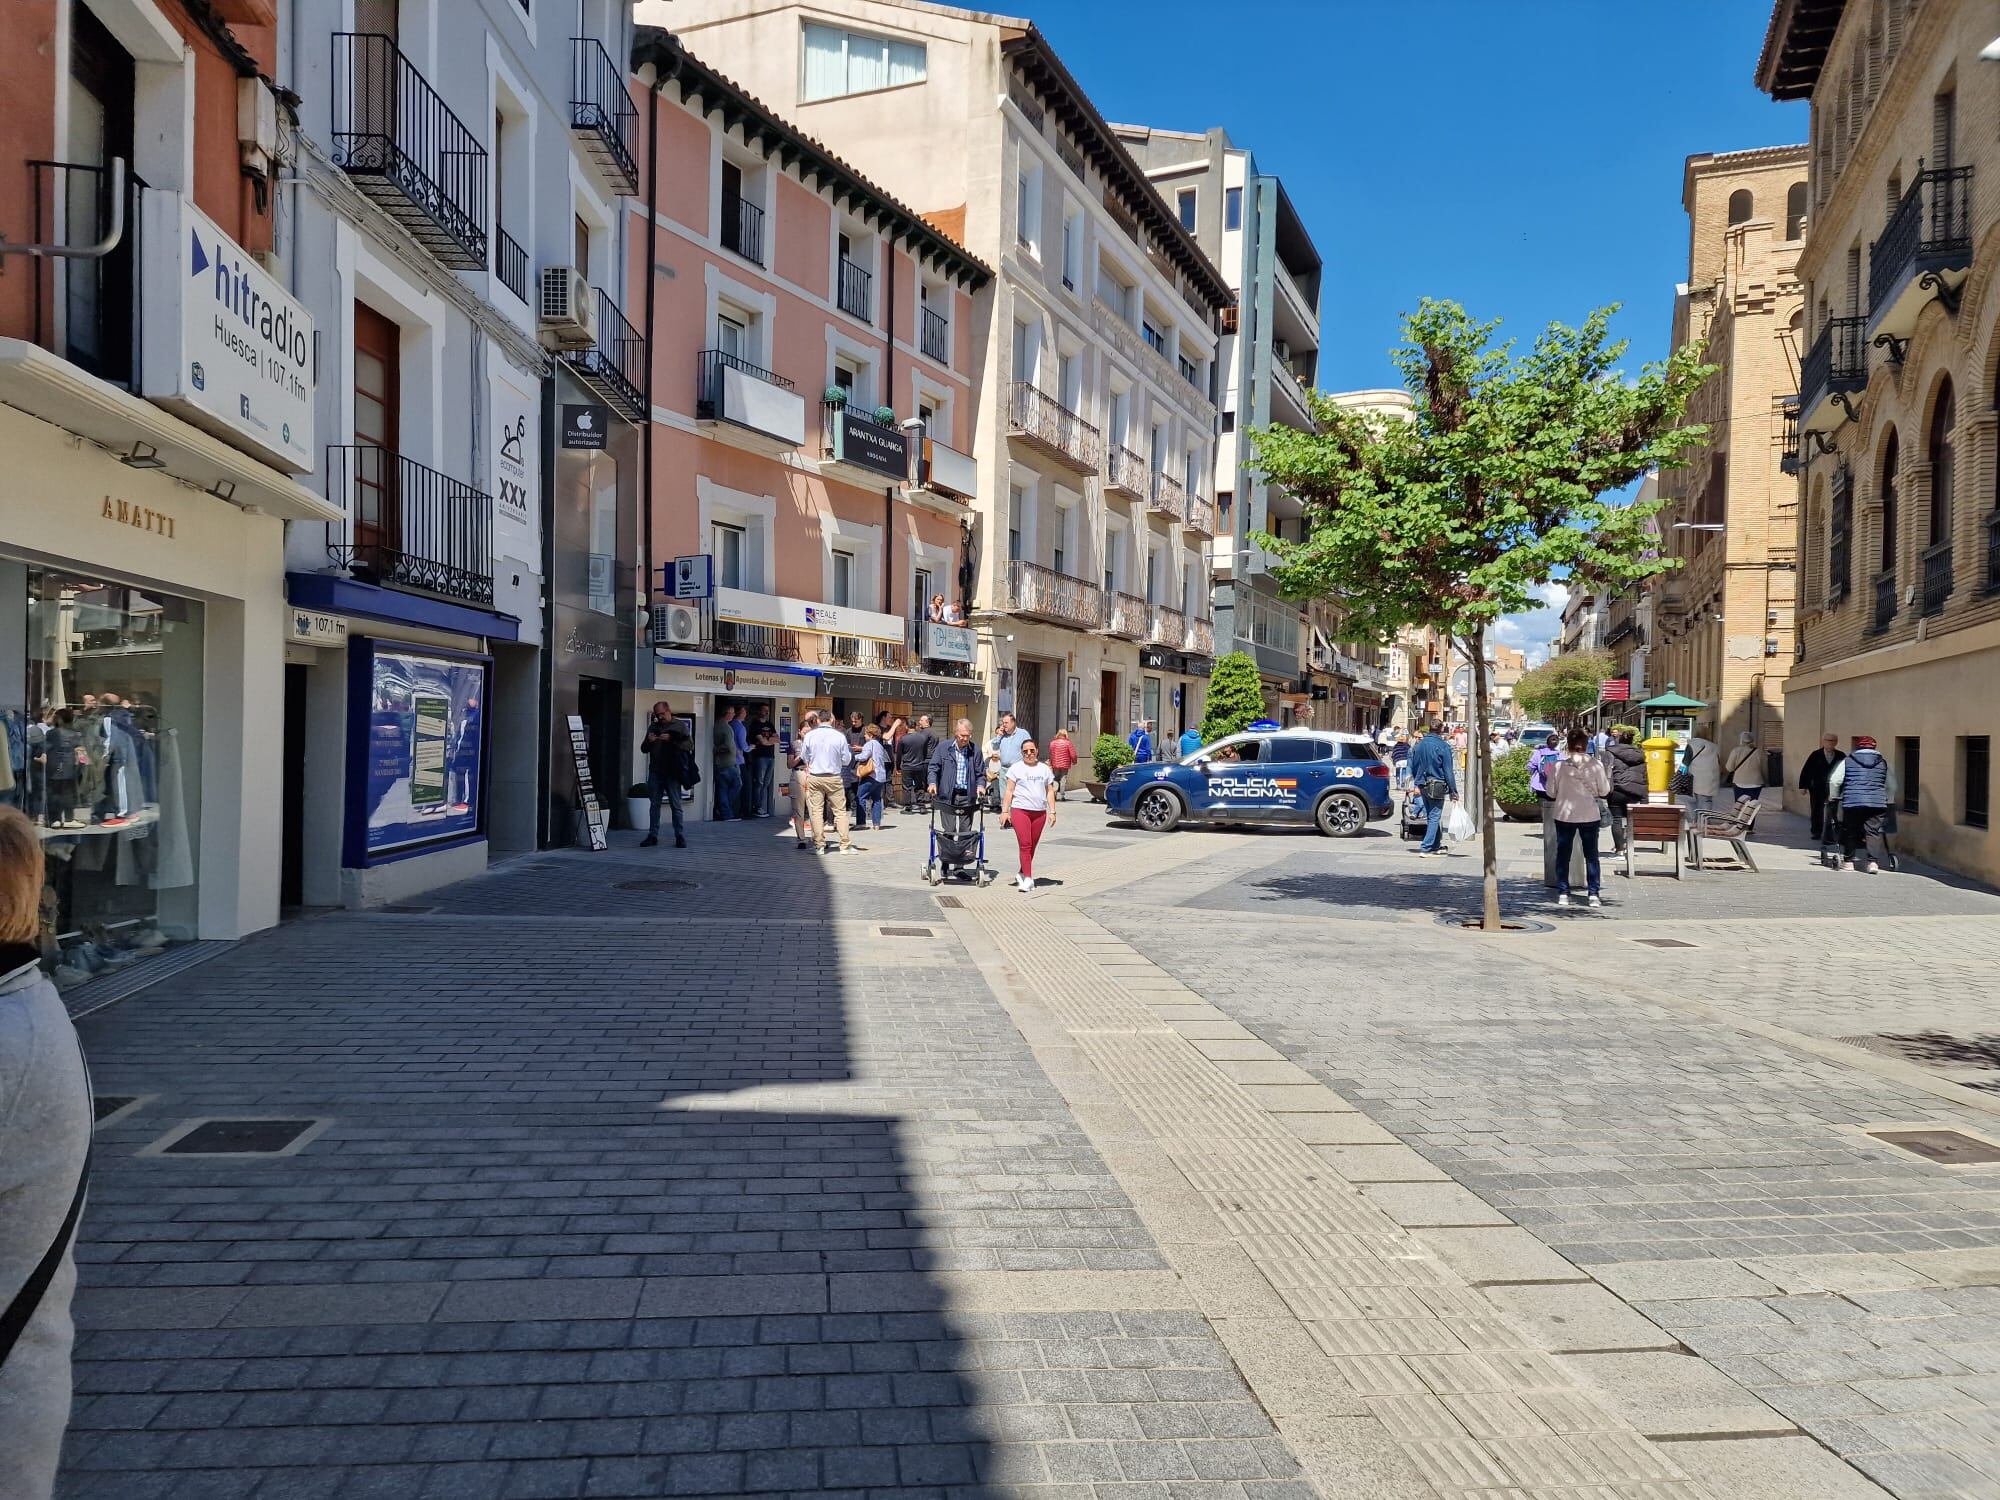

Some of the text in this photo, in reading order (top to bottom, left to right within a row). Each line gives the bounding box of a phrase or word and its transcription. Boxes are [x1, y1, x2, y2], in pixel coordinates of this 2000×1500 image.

[215, 244, 305, 368] hitradio
[214, 314, 257, 368] Huesca
[567, 430, 603, 438] Distribuidor
[499, 477, 527, 512] XXX
[102, 494, 176, 540] AMATTI
[815, 608, 837, 620] REALE
[336, 620, 346, 635] fm
[1150, 655, 1161, 666] IN
[719, 675, 724, 684] y
[736, 675, 759, 685] Apuestas
[769, 678, 787, 687] Estado
[879, 681, 893, 696] EL
[1336, 767, 1364, 778] 200
[1208, 788, 1296, 798] NACIONAL
